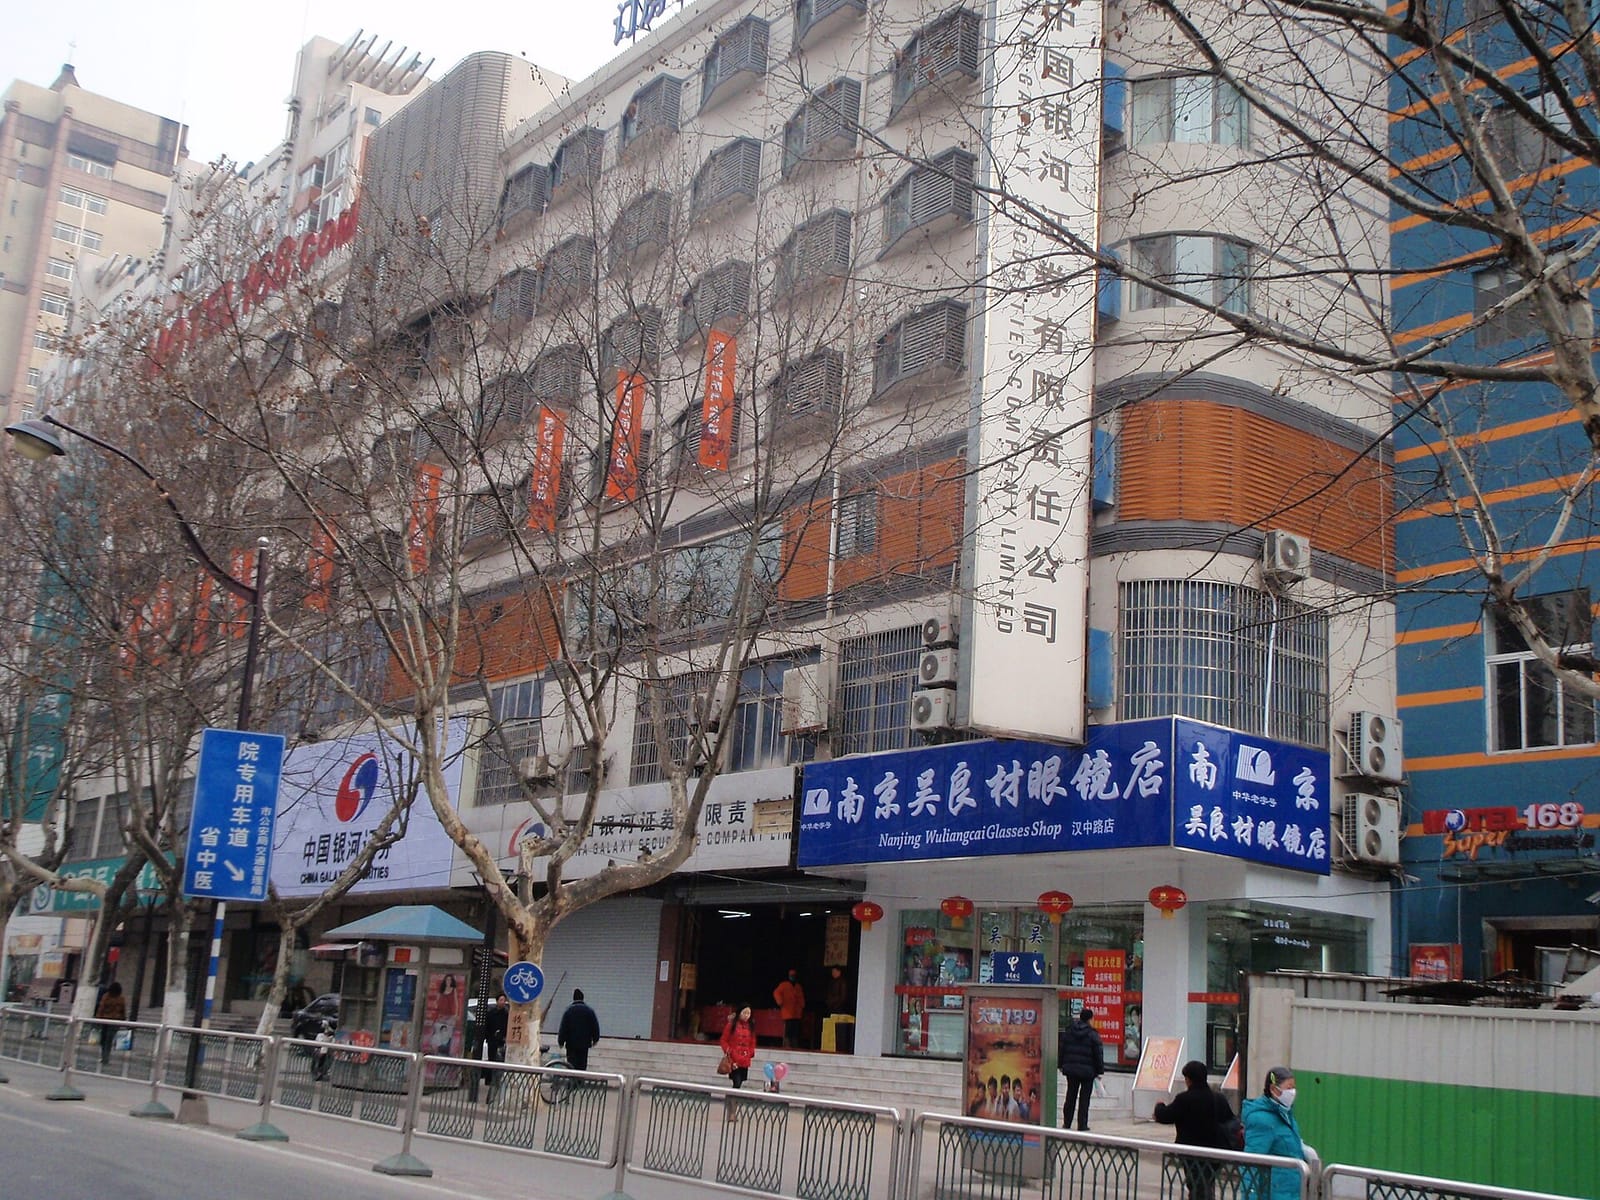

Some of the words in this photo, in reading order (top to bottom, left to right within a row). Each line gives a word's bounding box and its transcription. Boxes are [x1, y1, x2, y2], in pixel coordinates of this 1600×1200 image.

[997, 528, 1017, 635] LIMITED
[227, 741, 261, 848] 院专用车道
[837, 741, 1165, 824] 南京吴良材眼镜店
[1189, 742, 1217, 791] 南
[1293, 767, 1319, 811] 京
[878, 832, 921, 850] Nanjing
[925, 824, 985, 846] Wuliangcai
[986, 822, 1029, 840] Glasses
[1031, 820, 1062, 840] Shop
[1071, 818, 1115, 836] 汉中路店
[1185, 804, 1326, 860] 吴良材眼镜店
[1523, 802, 1584, 828] 168
[193, 826, 222, 890] 省中医
[302, 827, 392, 868] 中国银河
[1441, 831, 1512, 861] Super
